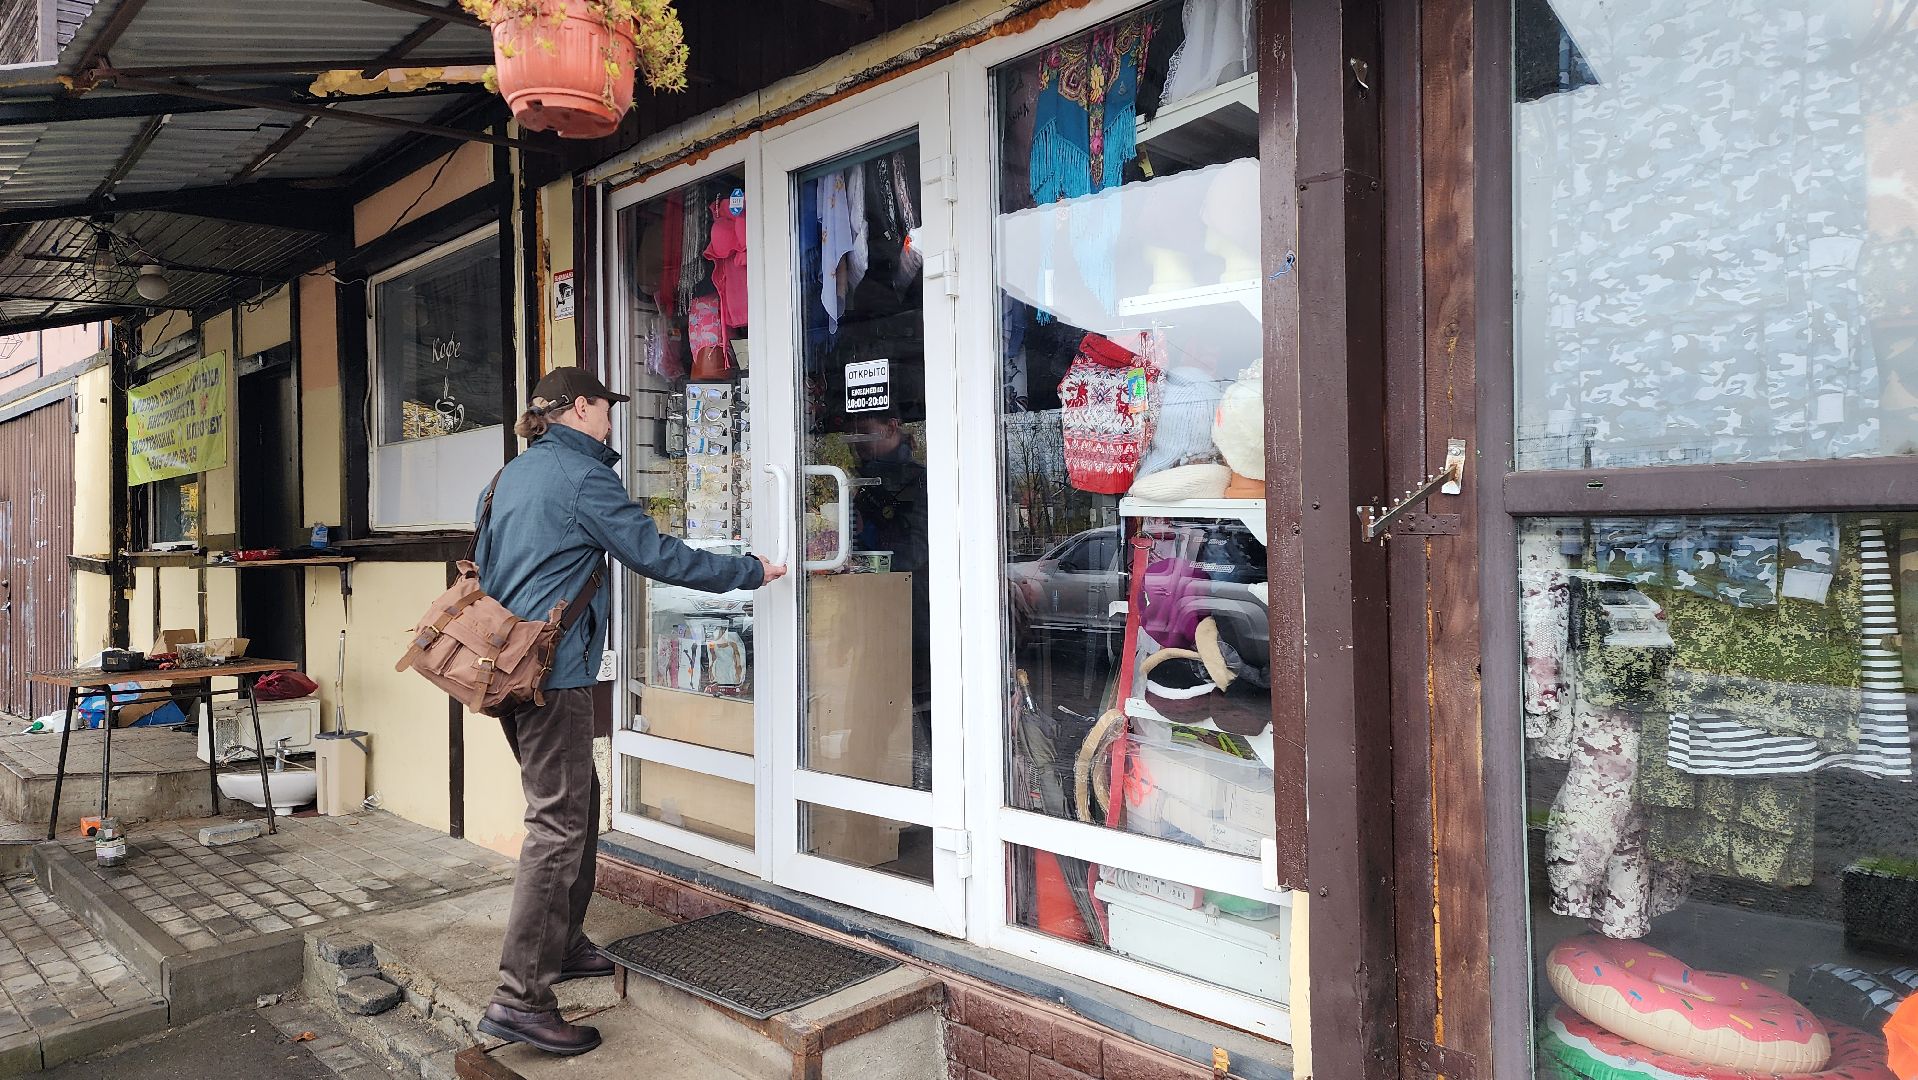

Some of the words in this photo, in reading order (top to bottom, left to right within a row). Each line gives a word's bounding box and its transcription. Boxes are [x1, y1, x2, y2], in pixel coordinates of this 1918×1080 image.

[432, 330, 461, 370] Кофе
[848, 367, 886, 379] ОТКРЫТО
[186, 414, 223, 440] КЛЮЧЕЙ
